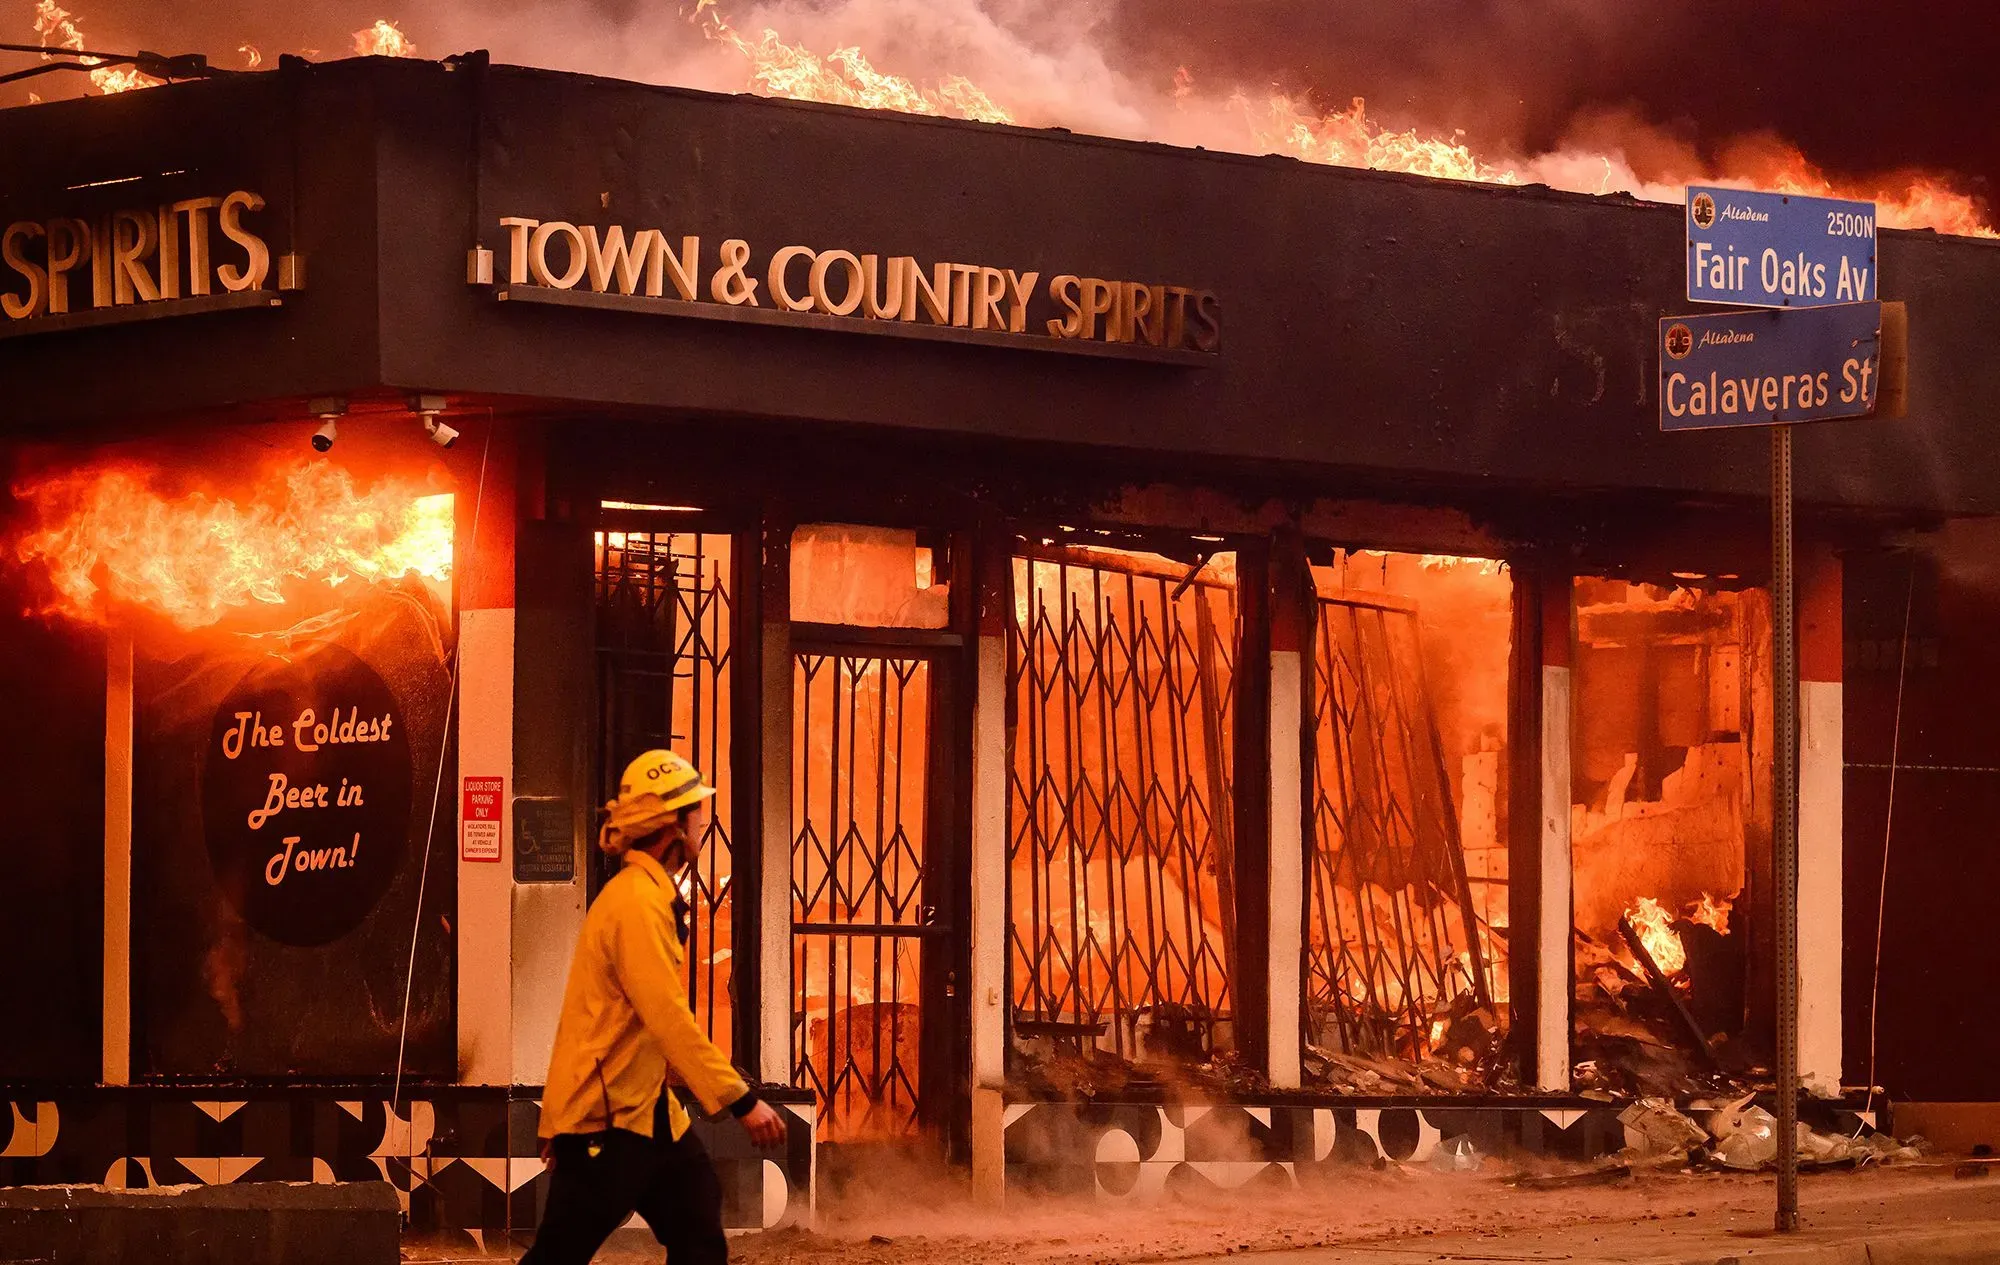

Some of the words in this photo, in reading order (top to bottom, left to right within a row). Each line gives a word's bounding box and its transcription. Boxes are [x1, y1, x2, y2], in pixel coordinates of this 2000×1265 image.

[1720, 204, 1769, 223] Altadena
[1827, 212, 1874, 238] 2500N
[1, 190, 270, 320] SPIRITS
[1696, 242, 1749, 291] Fair
[1761, 247, 1826, 298] Oaks
[1836, 255, 1868, 302] Av
[500, 217, 699, 301] TOWN
[711, 239, 758, 307] &
[768, 246, 1039, 332] COUNTRY
[1047, 275, 1221, 351] SPIRITS
[1698, 330, 1755, 349] Altadena
[1667, 371, 1829, 417] Calaveras
[1840, 358, 1872, 404] St
[223, 711, 284, 759] The
[292, 706, 392, 752] Coldest
[248, 773, 329, 829] Beer
[337, 778, 363, 806] in
[465, 781, 484, 792] LIQUOR
[484, 781, 501, 792] STORE
[472, 794, 494, 805] PARKING
[475, 807, 489, 818] ONLY
[265, 832, 360, 886] Town!
